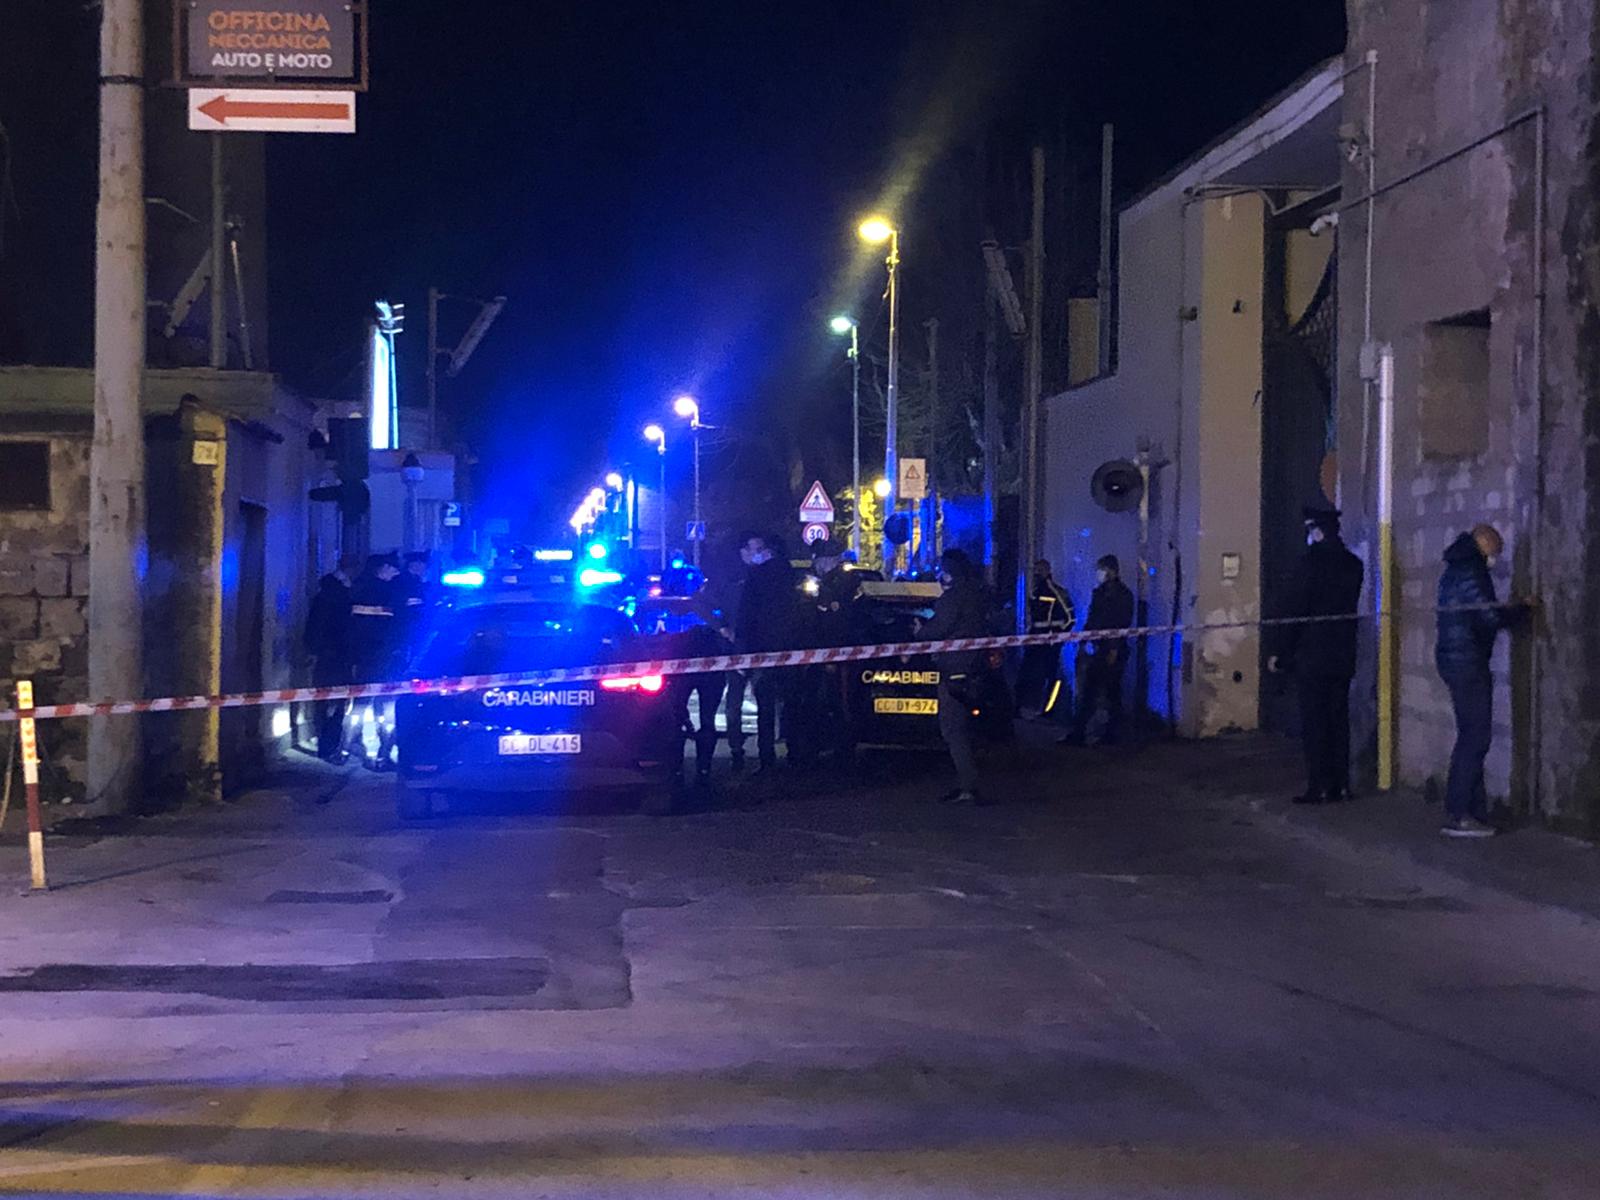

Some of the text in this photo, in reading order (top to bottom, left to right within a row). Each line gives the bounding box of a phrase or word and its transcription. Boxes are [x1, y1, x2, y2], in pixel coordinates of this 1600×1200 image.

[207, 10, 331, 32] OFFICINA
[207, 33, 331, 49] MECCANICA
[212, 53, 333, 69] AUTO E MOTO
[808, 528, 824, 541] 30
[482, 690, 596, 707] CARABINIERI
